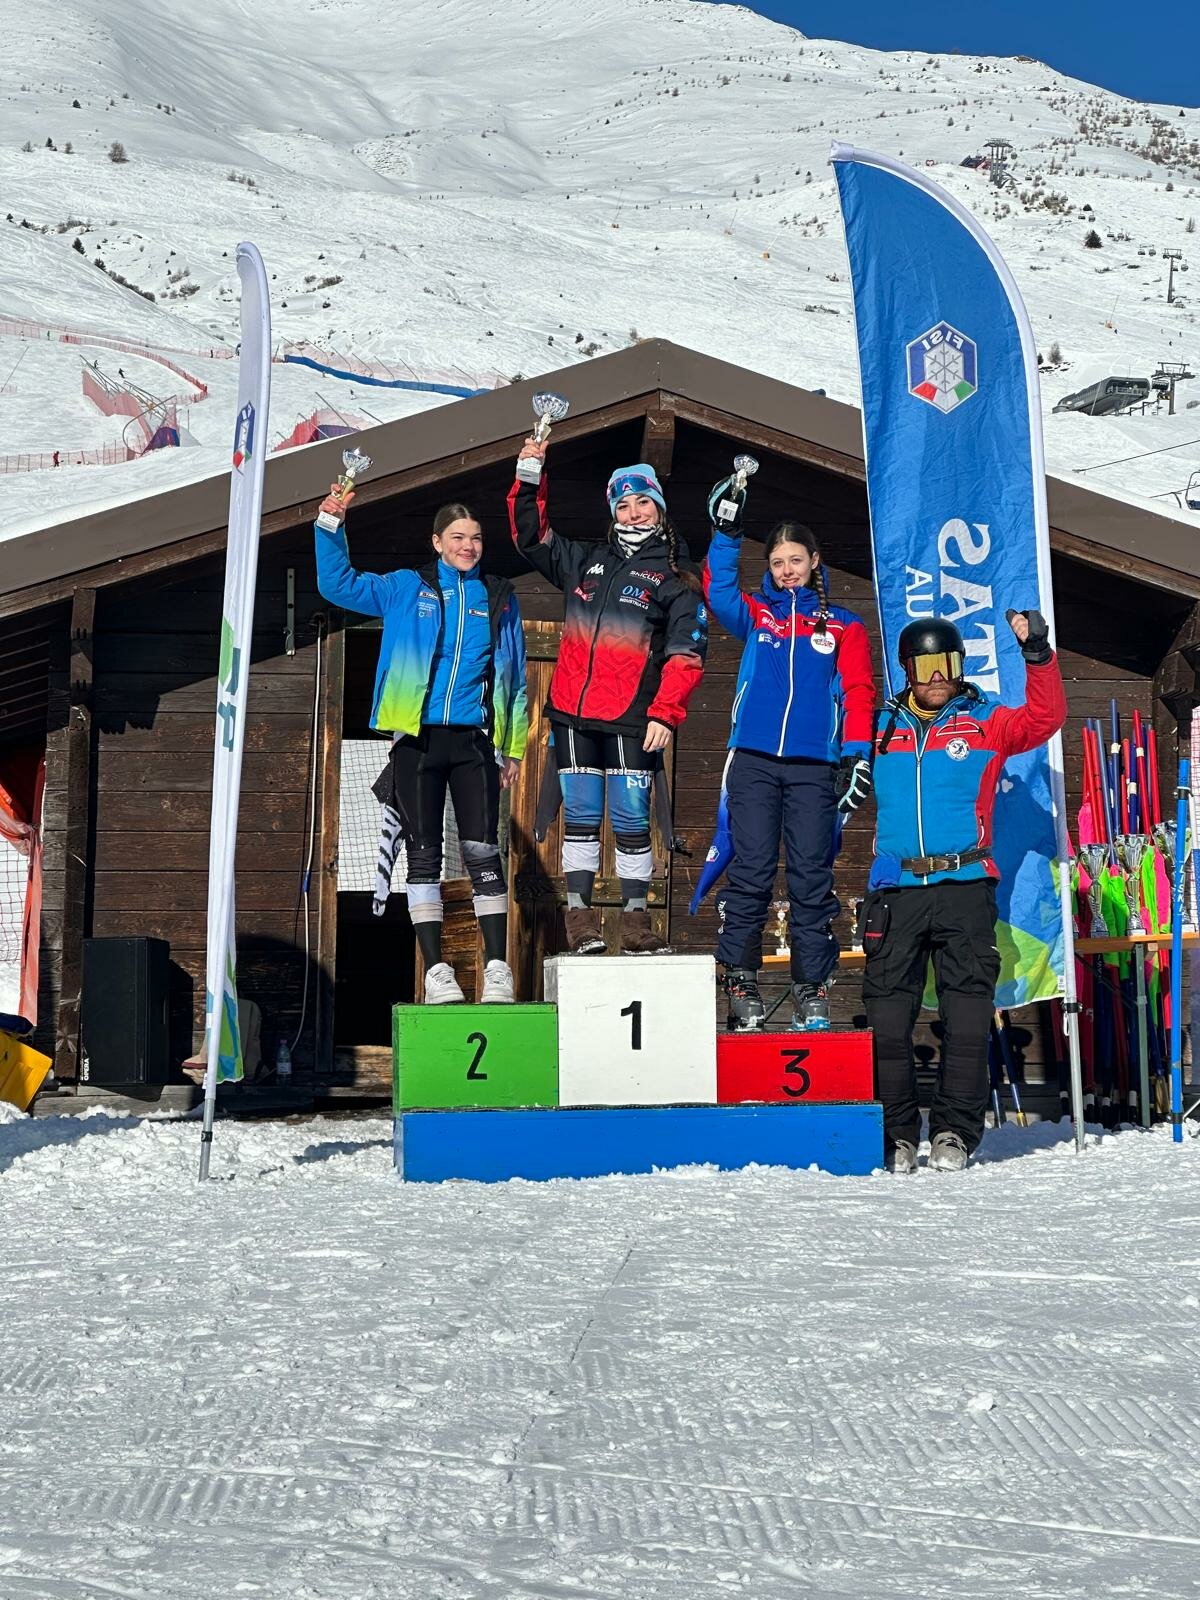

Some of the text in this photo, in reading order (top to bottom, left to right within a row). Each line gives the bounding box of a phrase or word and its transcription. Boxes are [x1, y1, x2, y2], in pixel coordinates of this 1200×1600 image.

[620, 1000, 643, 1050] 1
[466, 1032, 488, 1080] 2
[780, 1048, 811, 1097] 3
